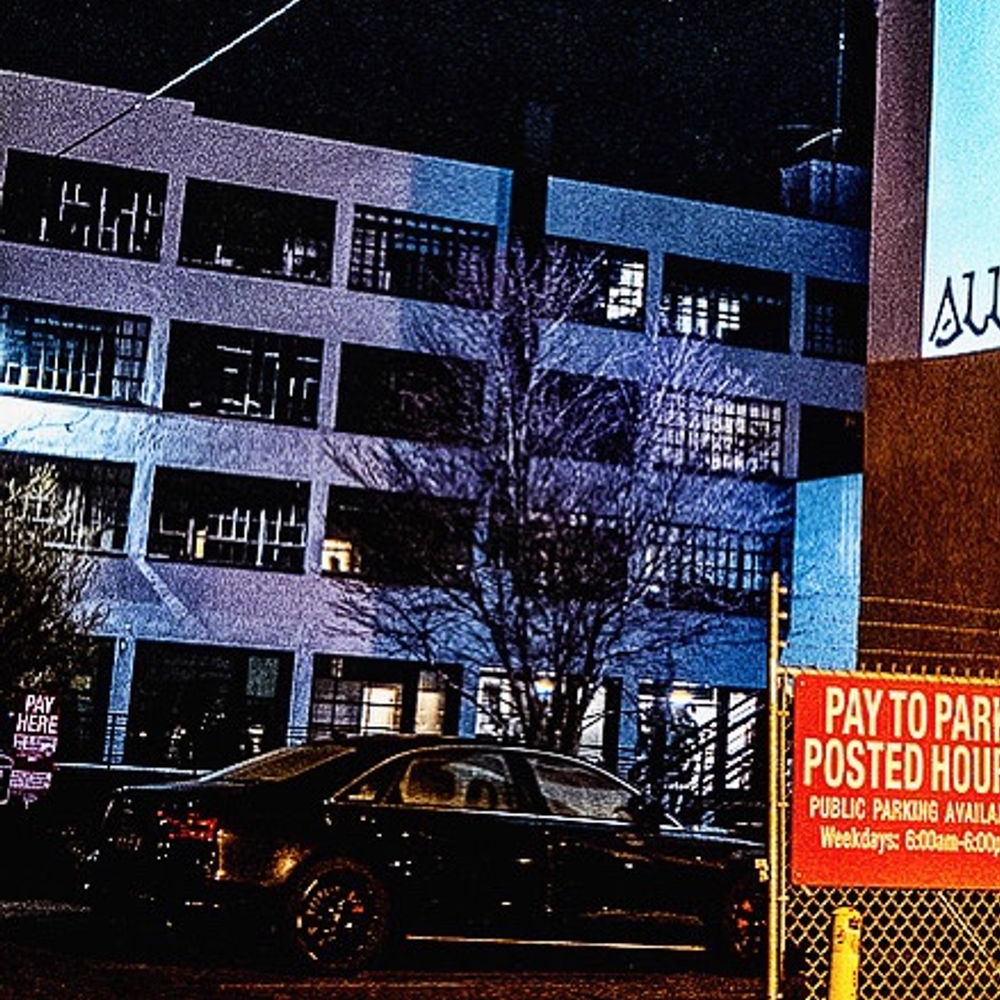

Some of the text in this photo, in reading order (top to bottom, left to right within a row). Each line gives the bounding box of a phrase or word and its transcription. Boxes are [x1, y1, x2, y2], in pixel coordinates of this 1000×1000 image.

[25, 694, 56, 714] PAY
[825, 686, 884, 737] PAY
[889, 690, 928, 740] TO
[16, 712, 58, 735] HERE
[803, 737, 924, 790] POSTED
[809, 796, 866, 819] PUBLIC
[873, 799, 939, 823] PARKING
[820, 825, 900, 854] Weekdays:
